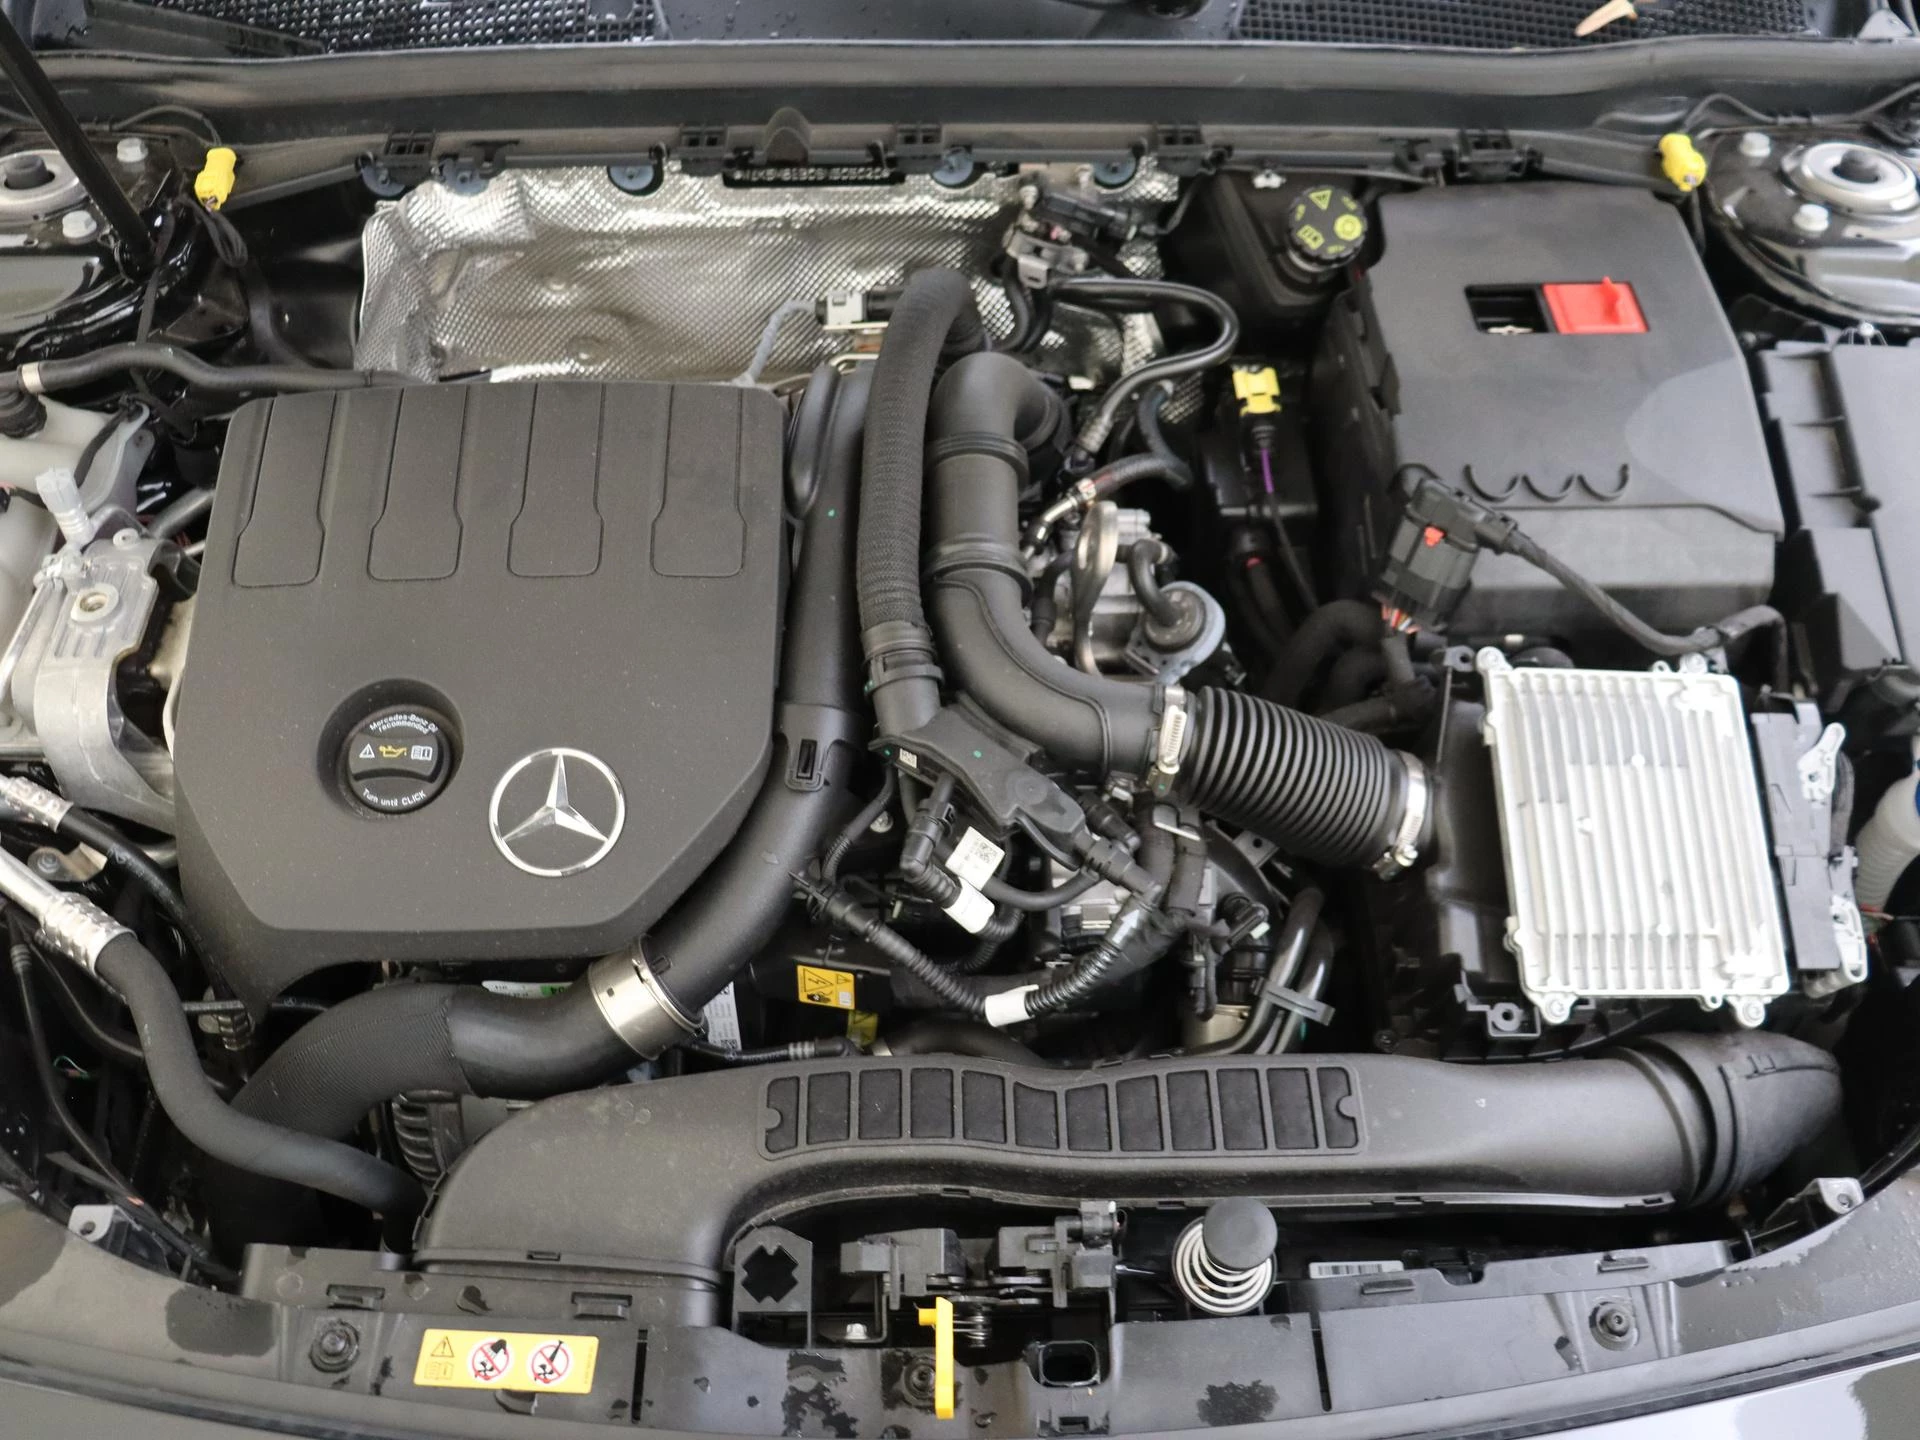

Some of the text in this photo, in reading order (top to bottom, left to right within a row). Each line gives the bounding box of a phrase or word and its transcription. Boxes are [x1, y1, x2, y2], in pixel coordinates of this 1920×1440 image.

[369, 713, 428, 732] Mercedes-Benz
[378, 721, 430, 735] recommended
[362, 788, 427, 807] Turn until CLICK
